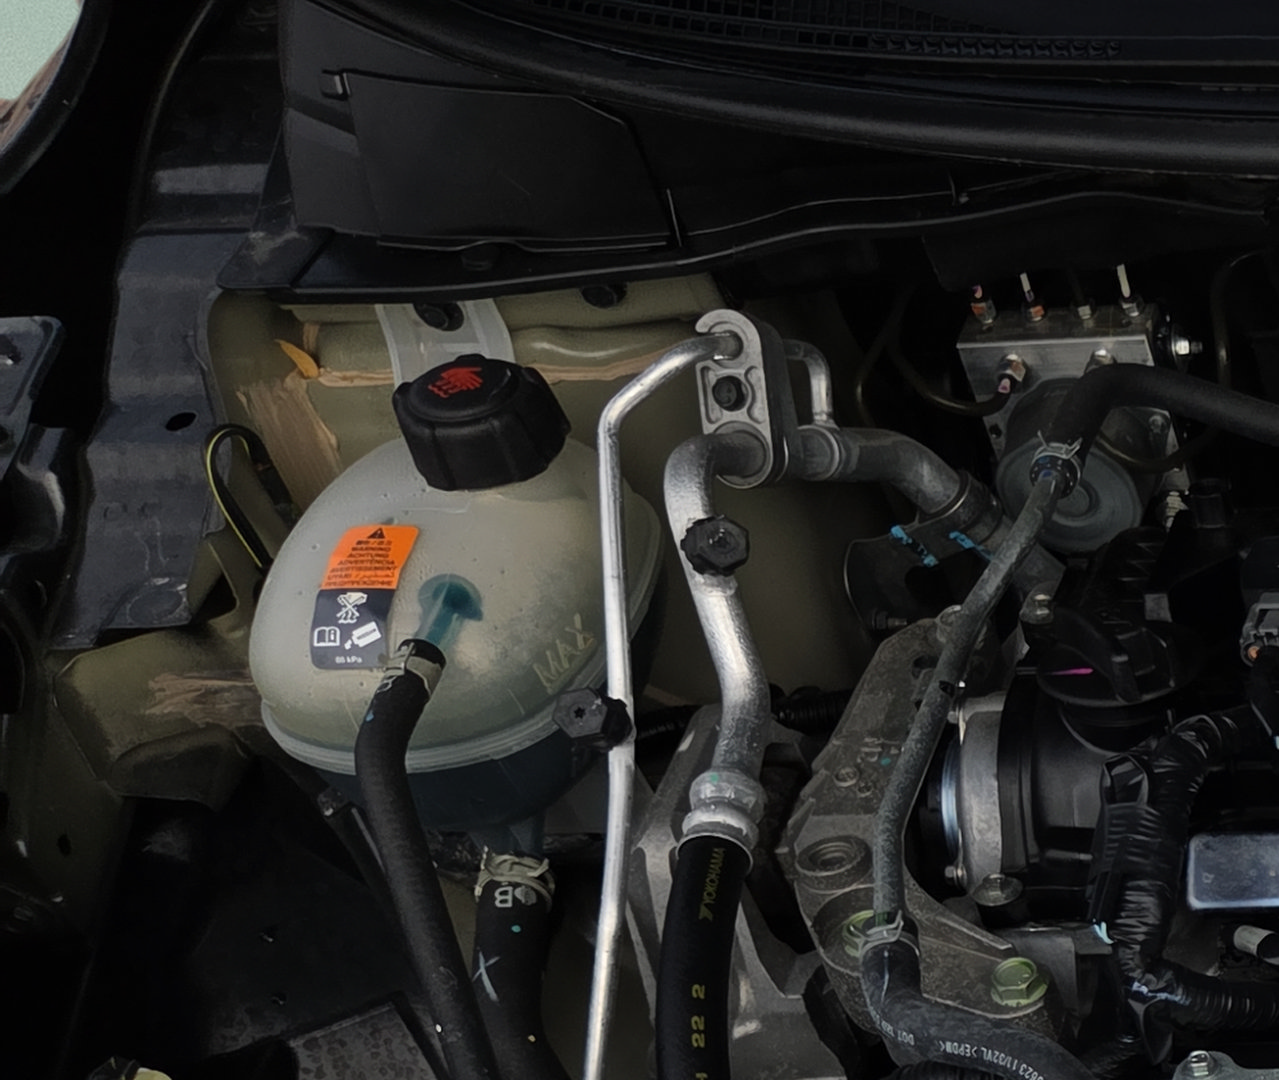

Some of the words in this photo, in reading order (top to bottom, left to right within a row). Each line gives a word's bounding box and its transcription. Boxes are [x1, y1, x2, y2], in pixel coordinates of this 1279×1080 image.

[532, 612, 596, 696] MAX
[702, 847, 727, 908] YOKOHAMA
[691, 983, 706, 999] 2
[691, 1015, 706, 1049] 22
